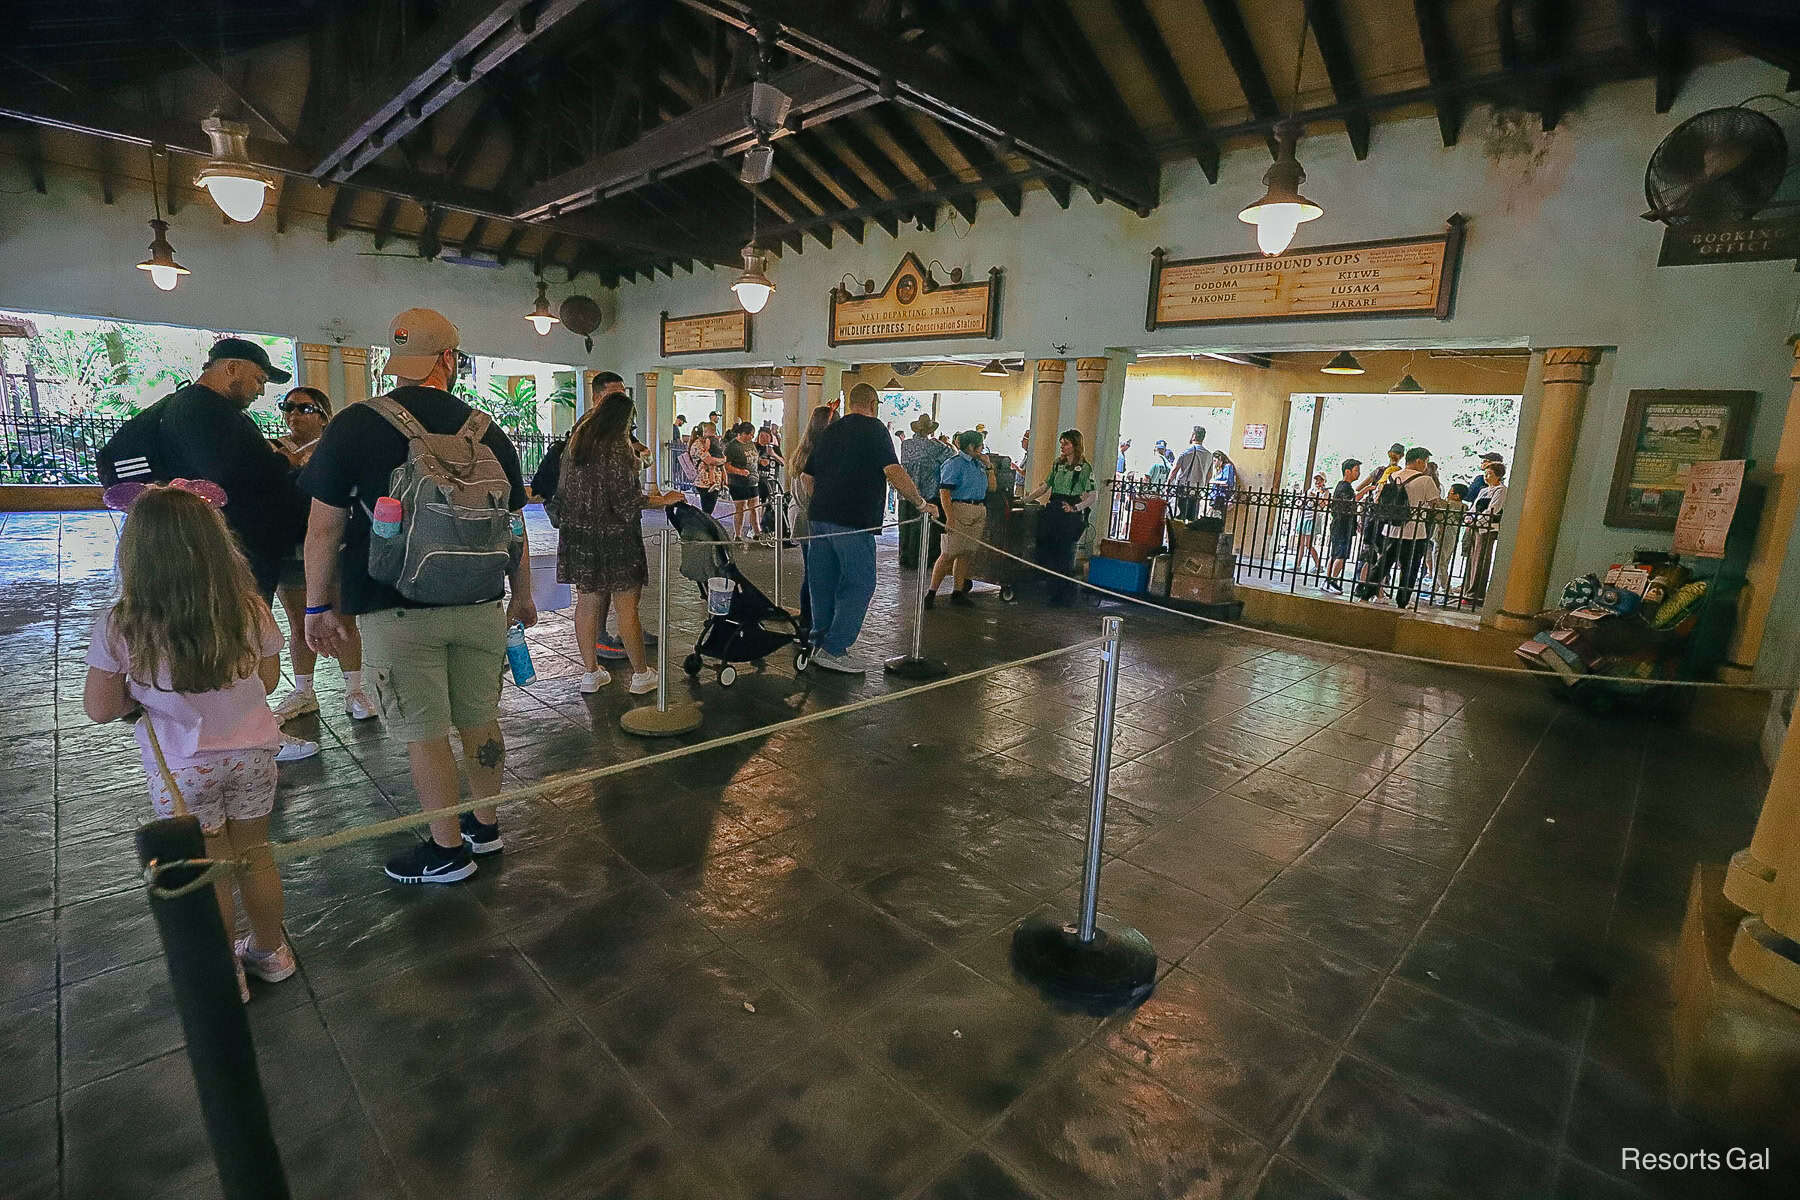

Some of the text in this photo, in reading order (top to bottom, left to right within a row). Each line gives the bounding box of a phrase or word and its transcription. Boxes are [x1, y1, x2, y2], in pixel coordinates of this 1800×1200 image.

[1223, 258, 1312, 275] SOUTHBOUND
[1317, 253, 1360, 267] STOPS
[1338, 269, 1380, 280] KITWE
[1194, 280, 1238, 291] DODOMA
[1331, 284, 1380, 295] LUSAKA
[1191, 293, 1237, 304] NAKONDE
[1331, 298, 1377, 308] HARARE
[861, 306, 956, 321] NEXT DEPARTING TRAIN
[840, 325, 870, 337] WILDLIFE
[872, 323, 904, 335] EXPRESS
[916, 320, 956, 332] Conservation
[957, 319, 979, 329] Station
